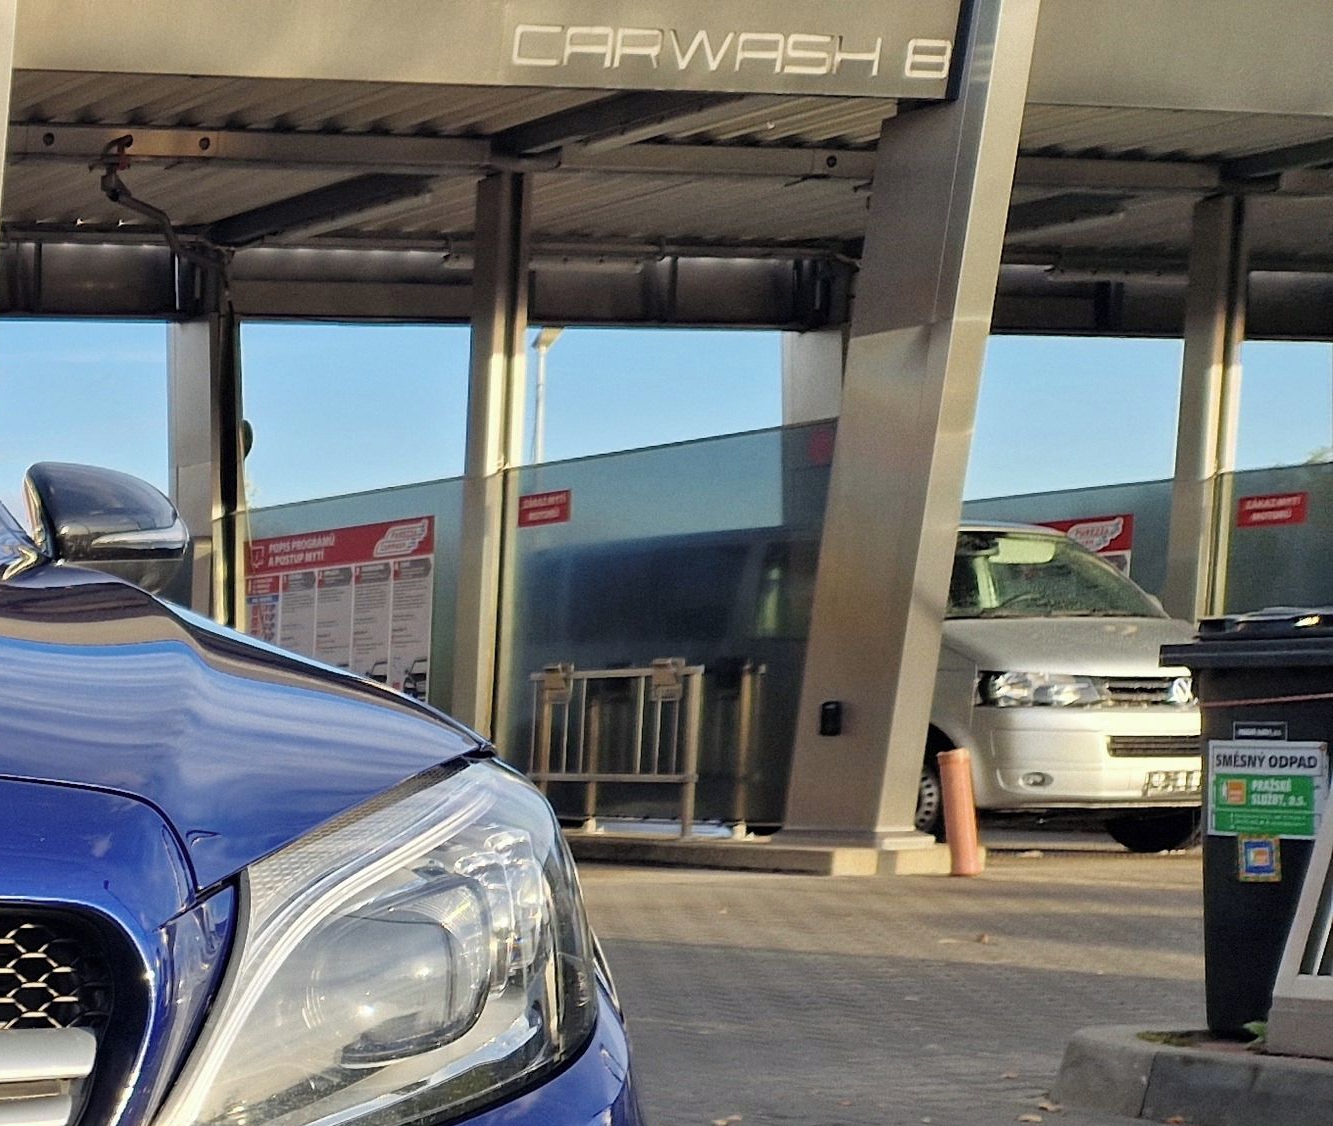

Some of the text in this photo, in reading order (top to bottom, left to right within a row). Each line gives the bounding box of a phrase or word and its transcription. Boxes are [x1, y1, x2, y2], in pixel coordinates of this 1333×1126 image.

[511, 22, 953, 80] CARWASH 8
[1268, 755, 1318, 769] ODPAD
